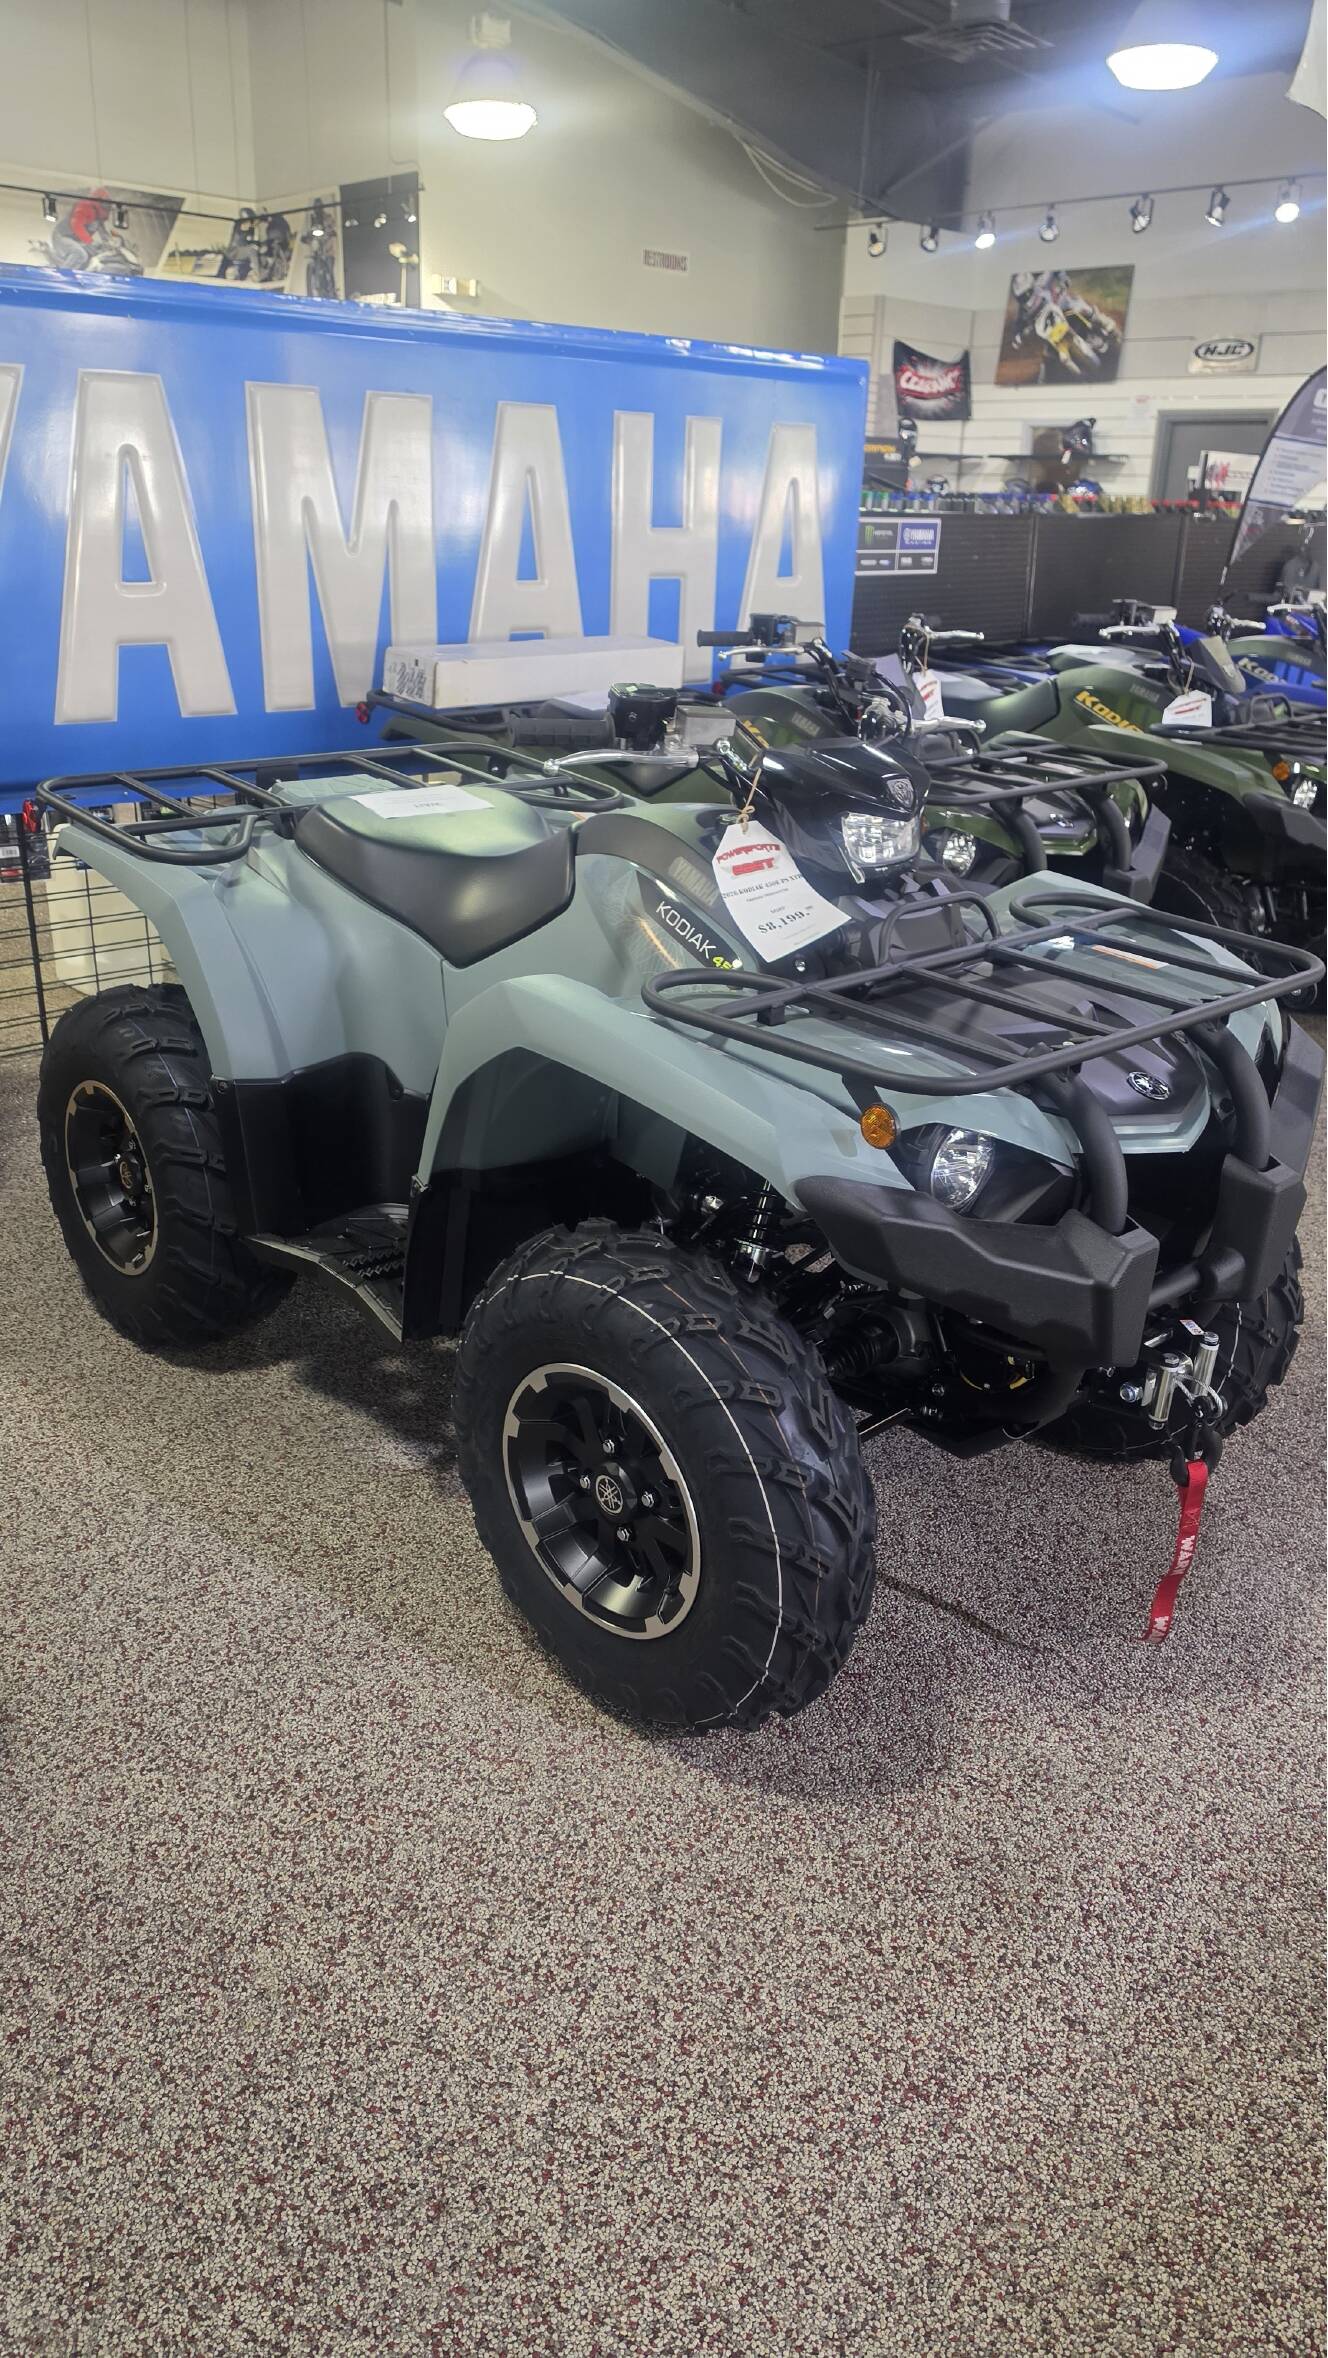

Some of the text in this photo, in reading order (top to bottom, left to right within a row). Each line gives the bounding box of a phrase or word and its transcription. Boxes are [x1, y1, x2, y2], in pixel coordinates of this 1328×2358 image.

[0, 362, 826, 725] AMAHA
[668, 856, 719, 907] YAMAHA
[656, 901, 737, 970] KODIAK 45
